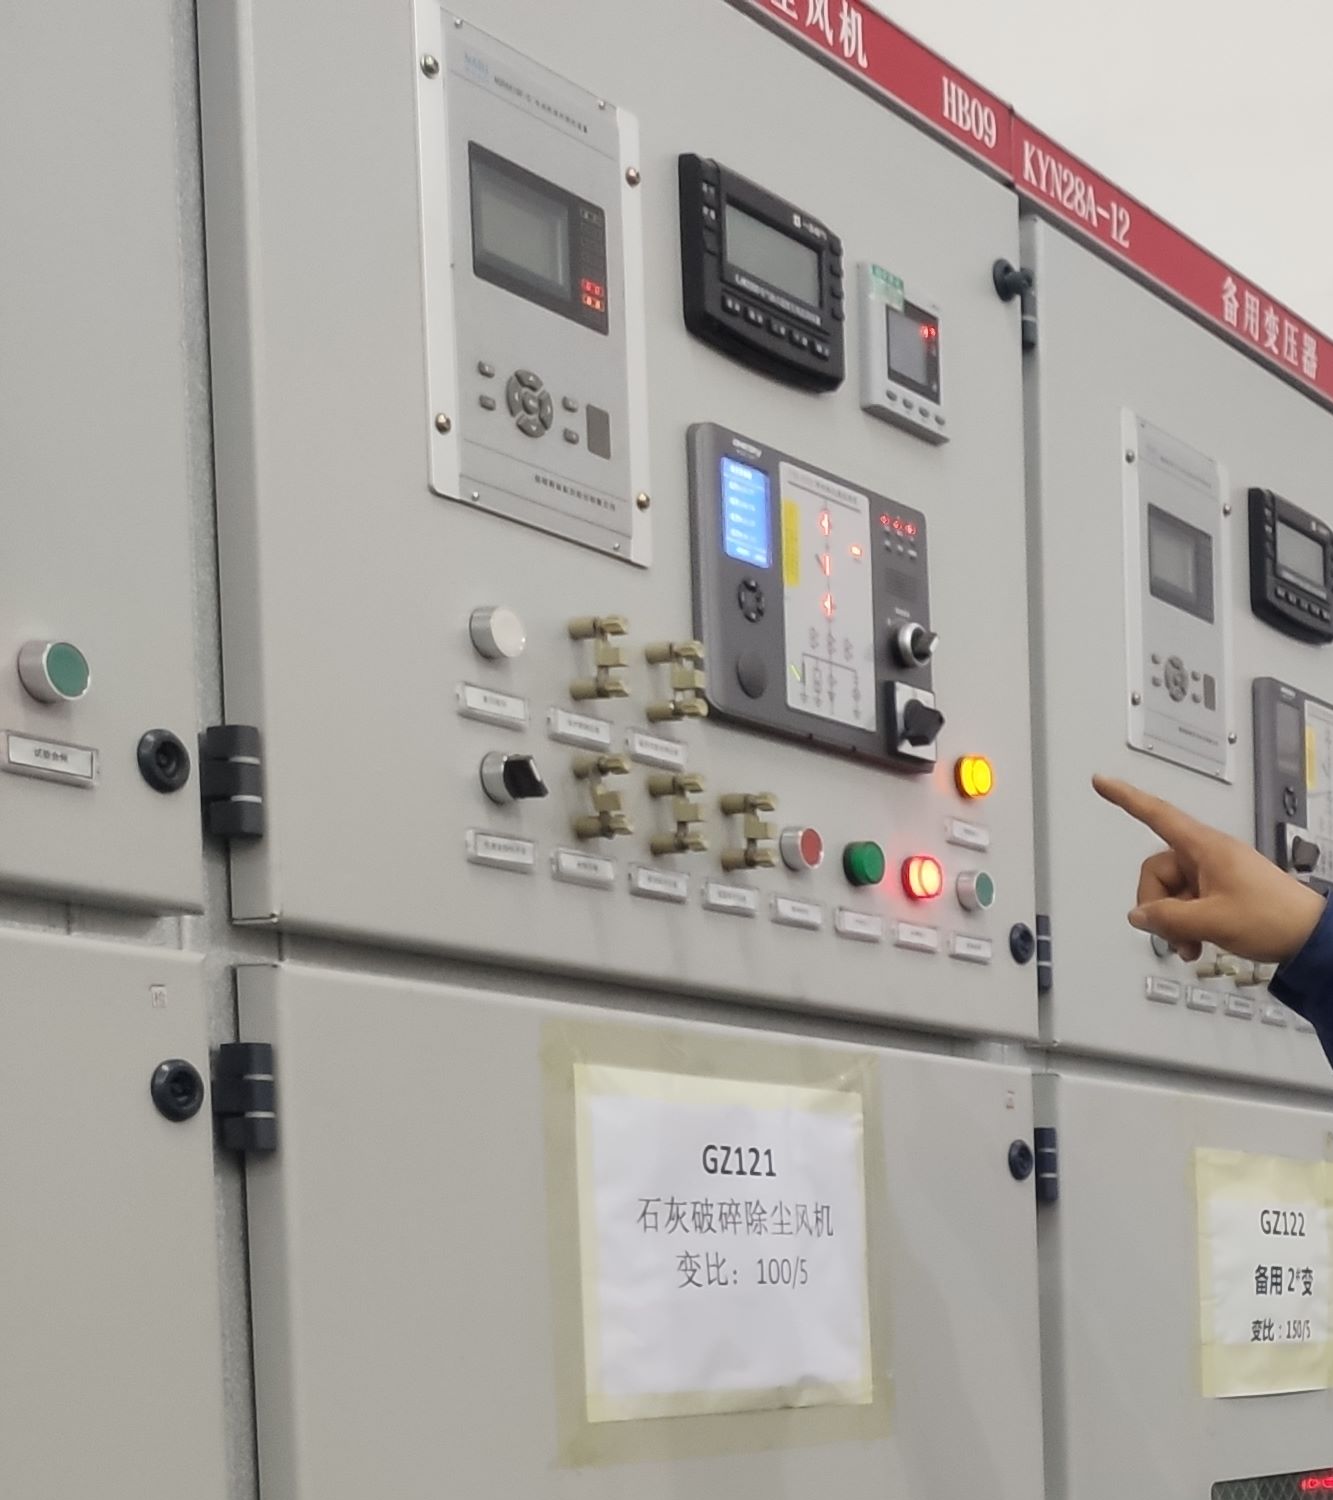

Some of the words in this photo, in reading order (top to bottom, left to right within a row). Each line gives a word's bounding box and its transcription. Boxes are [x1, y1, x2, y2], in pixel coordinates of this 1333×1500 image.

[941, 75, 997, 149] HB09
[1022, 140, 1131, 248] KYN28A-12
[1221, 275, 1318, 381] 备用变压器
[702, 1144, 777, 1177] GZ121
[635, 1196, 835, 1239] 石灰破碎除尘风机
[1260, 1209, 1306, 1237] GZ122
